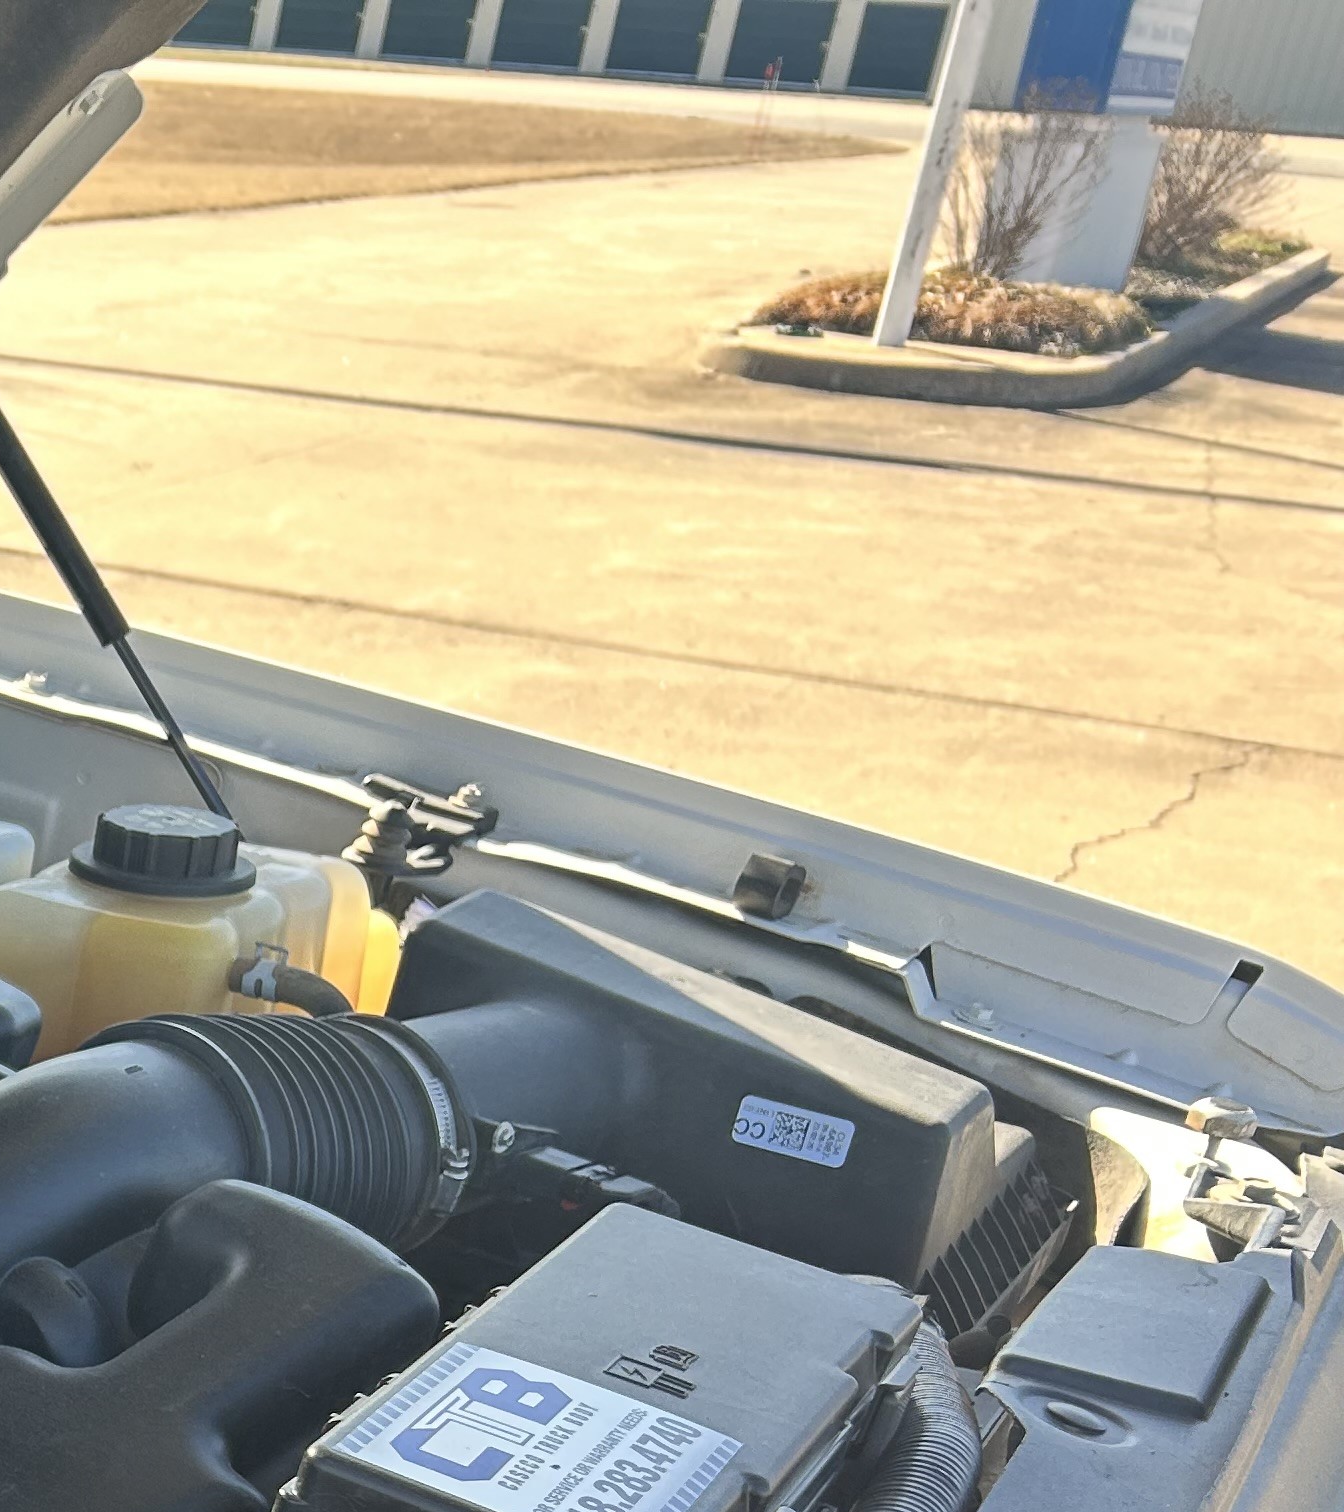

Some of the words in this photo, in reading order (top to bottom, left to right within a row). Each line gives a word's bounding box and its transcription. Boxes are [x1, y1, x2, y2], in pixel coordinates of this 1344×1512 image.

[495, 1452, 548, 1492] CASECO
[531, 1423, 576, 1455] TRUCK
[561, 1401, 600, 1427] BODY
[580, 1427, 629, 1466] WARRANTY
[571, 1461, 595, 1476] OR
[542, 1472, 585, 1506] SERVICE
